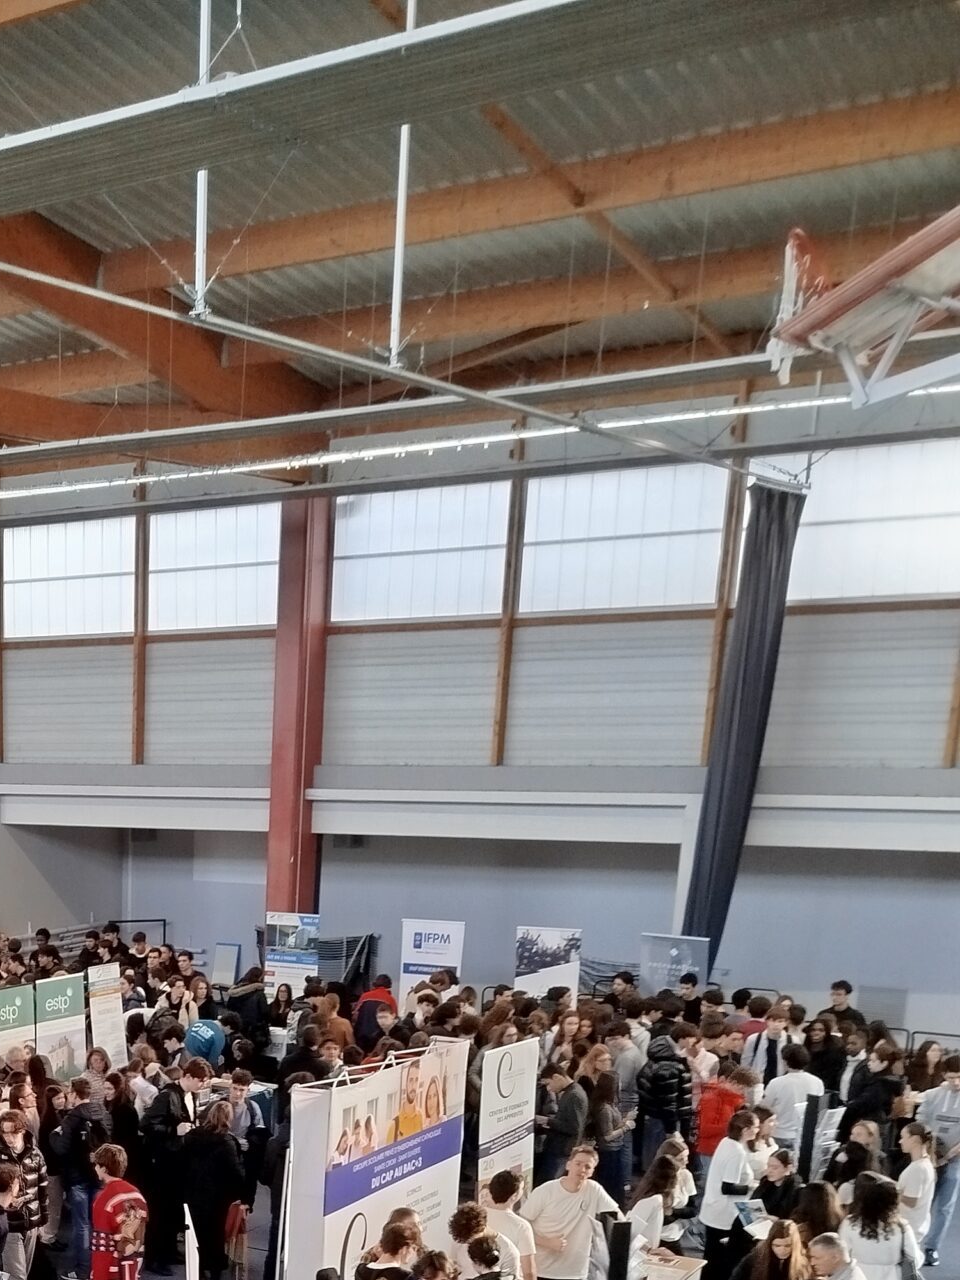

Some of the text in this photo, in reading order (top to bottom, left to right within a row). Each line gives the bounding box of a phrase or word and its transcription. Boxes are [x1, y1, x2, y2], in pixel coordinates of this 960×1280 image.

[423, 932, 451, 945] IFPM
[45, 995, 70, 1013] estp
[371, 1175, 380, 1189] DU
[381, 1170, 393, 1185] CAP
[393, 1166, 403, 1180] AU
